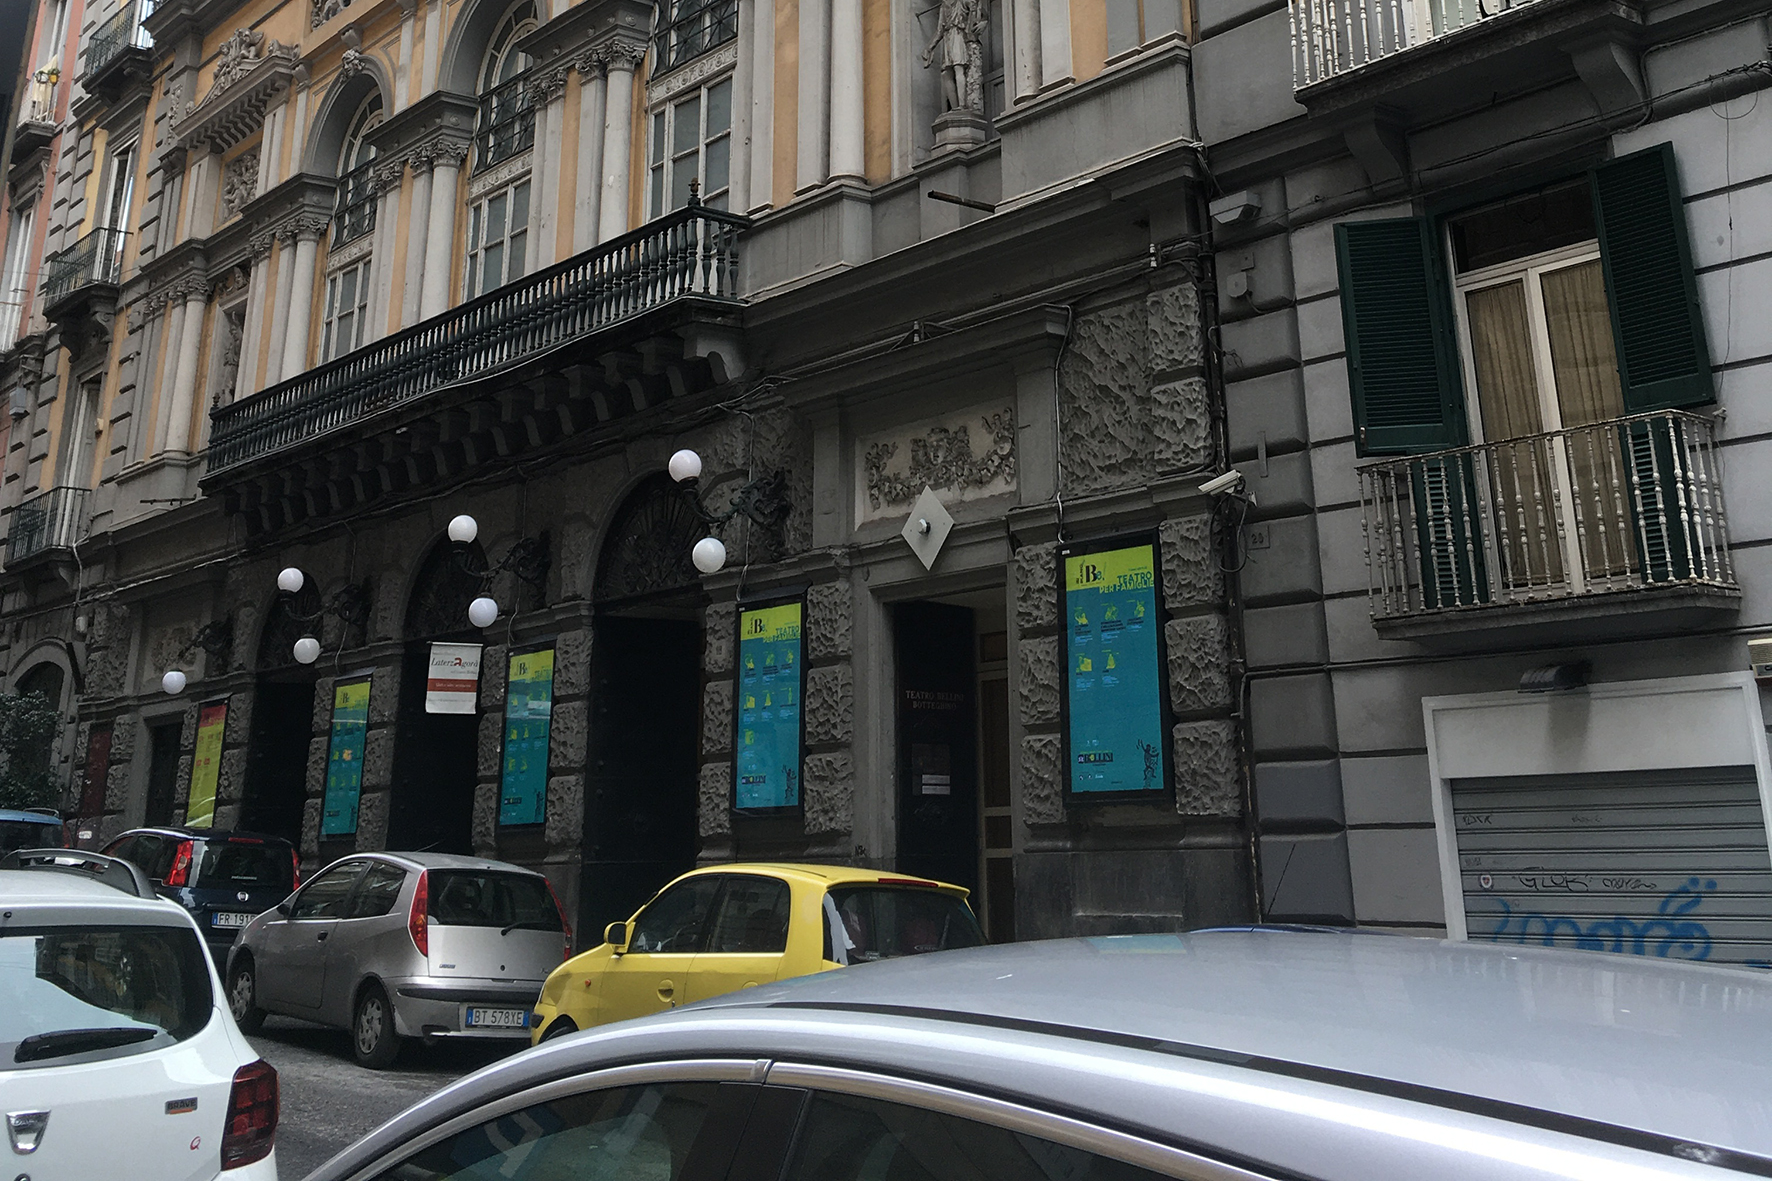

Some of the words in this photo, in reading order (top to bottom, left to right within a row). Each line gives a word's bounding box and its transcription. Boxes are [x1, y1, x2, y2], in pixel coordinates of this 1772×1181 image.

[1117, 571, 1153, 585] TEATRO
[1100, 584, 1114, 594] PER
[905, 689, 934, 700] TEATRO
[219, 913, 231, 925] FR
[474, 1010, 488, 1024] BT
[491, 1011, 523, 1025] 578XE
[167, 1098, 197, 1111] BRAVE
